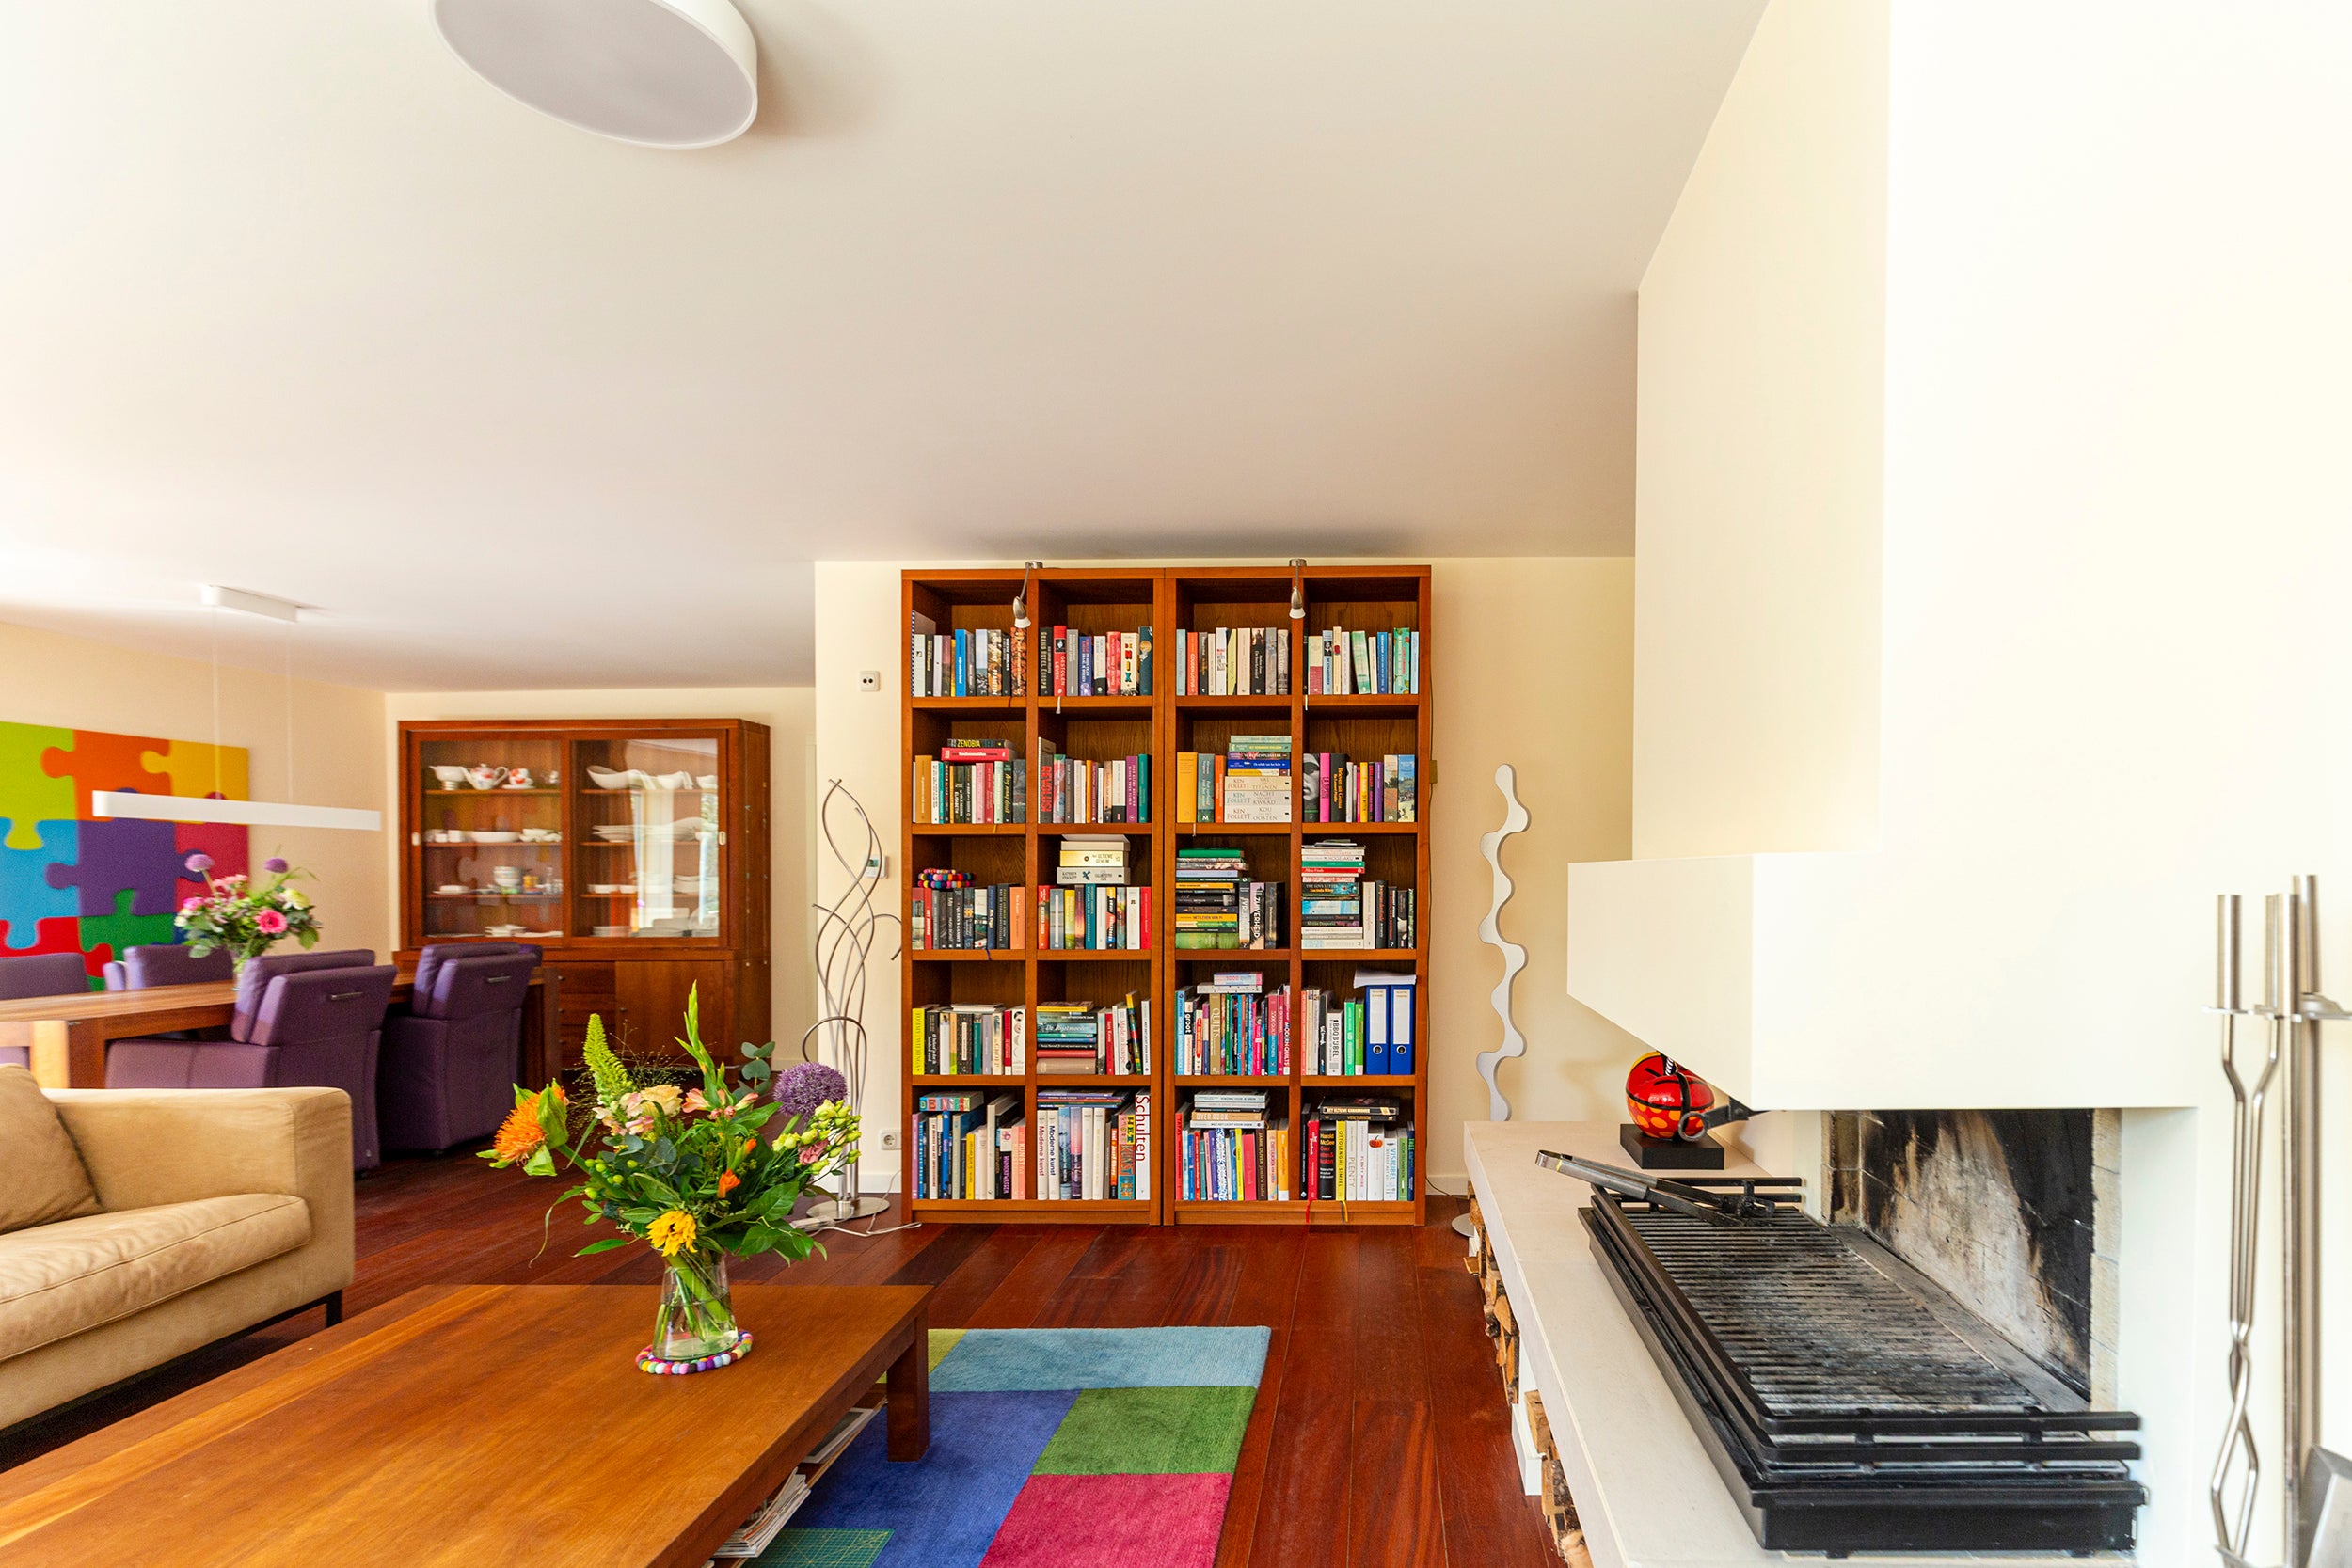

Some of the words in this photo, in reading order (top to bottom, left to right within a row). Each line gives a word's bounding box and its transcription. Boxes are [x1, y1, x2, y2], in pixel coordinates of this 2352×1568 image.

[957, 739, 981, 748] ZENOBIA
[1041, 766, 1053, 812] REVOLUSI
[1213, 1008, 1221, 1037] QUILTS
[1136, 1095, 1151, 1162] Schulten
